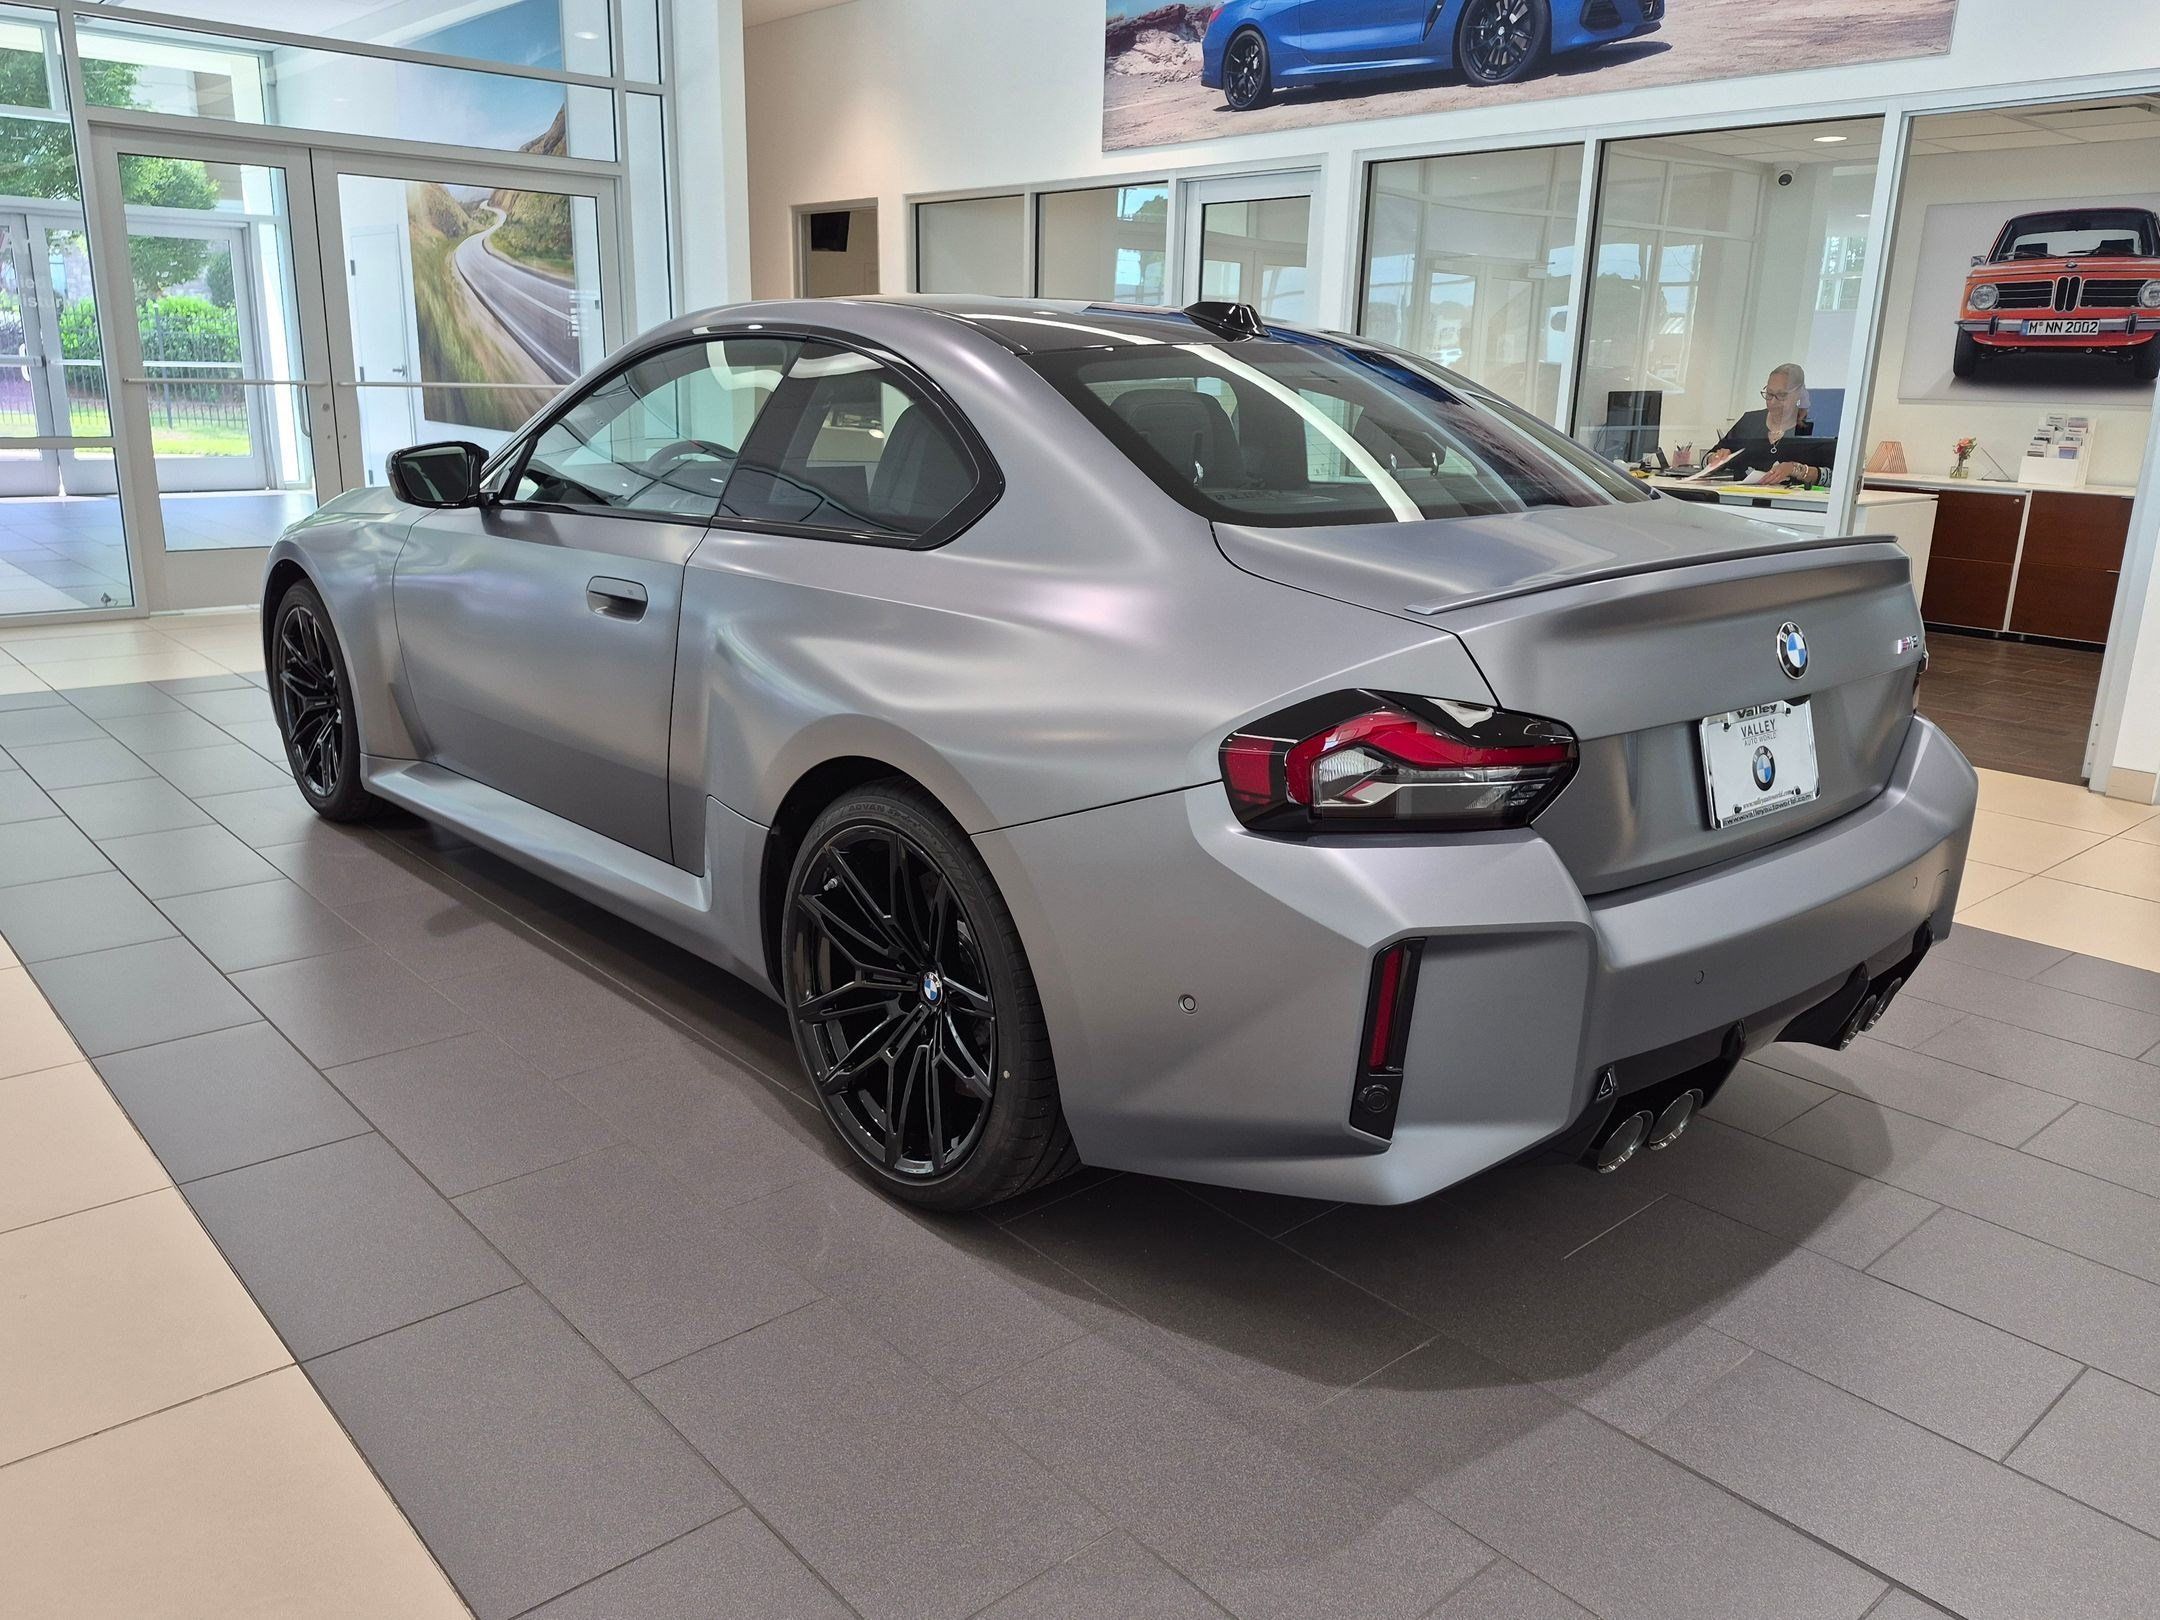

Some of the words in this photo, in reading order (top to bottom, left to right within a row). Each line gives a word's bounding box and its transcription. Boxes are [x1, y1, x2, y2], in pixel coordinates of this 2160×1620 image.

[2028, 321, 2039, 333] M
[2045, 321, 2063, 333] NN
[2065, 321, 2098, 333] 2002
[1736, 703, 1778, 719] Valley
[1740, 718, 1776, 738] VALLEY
[1744, 737, 1758, 746] AUTO
[1759, 732, 1777, 744] WORLD
[848, 803, 886, 812] ADVAN
